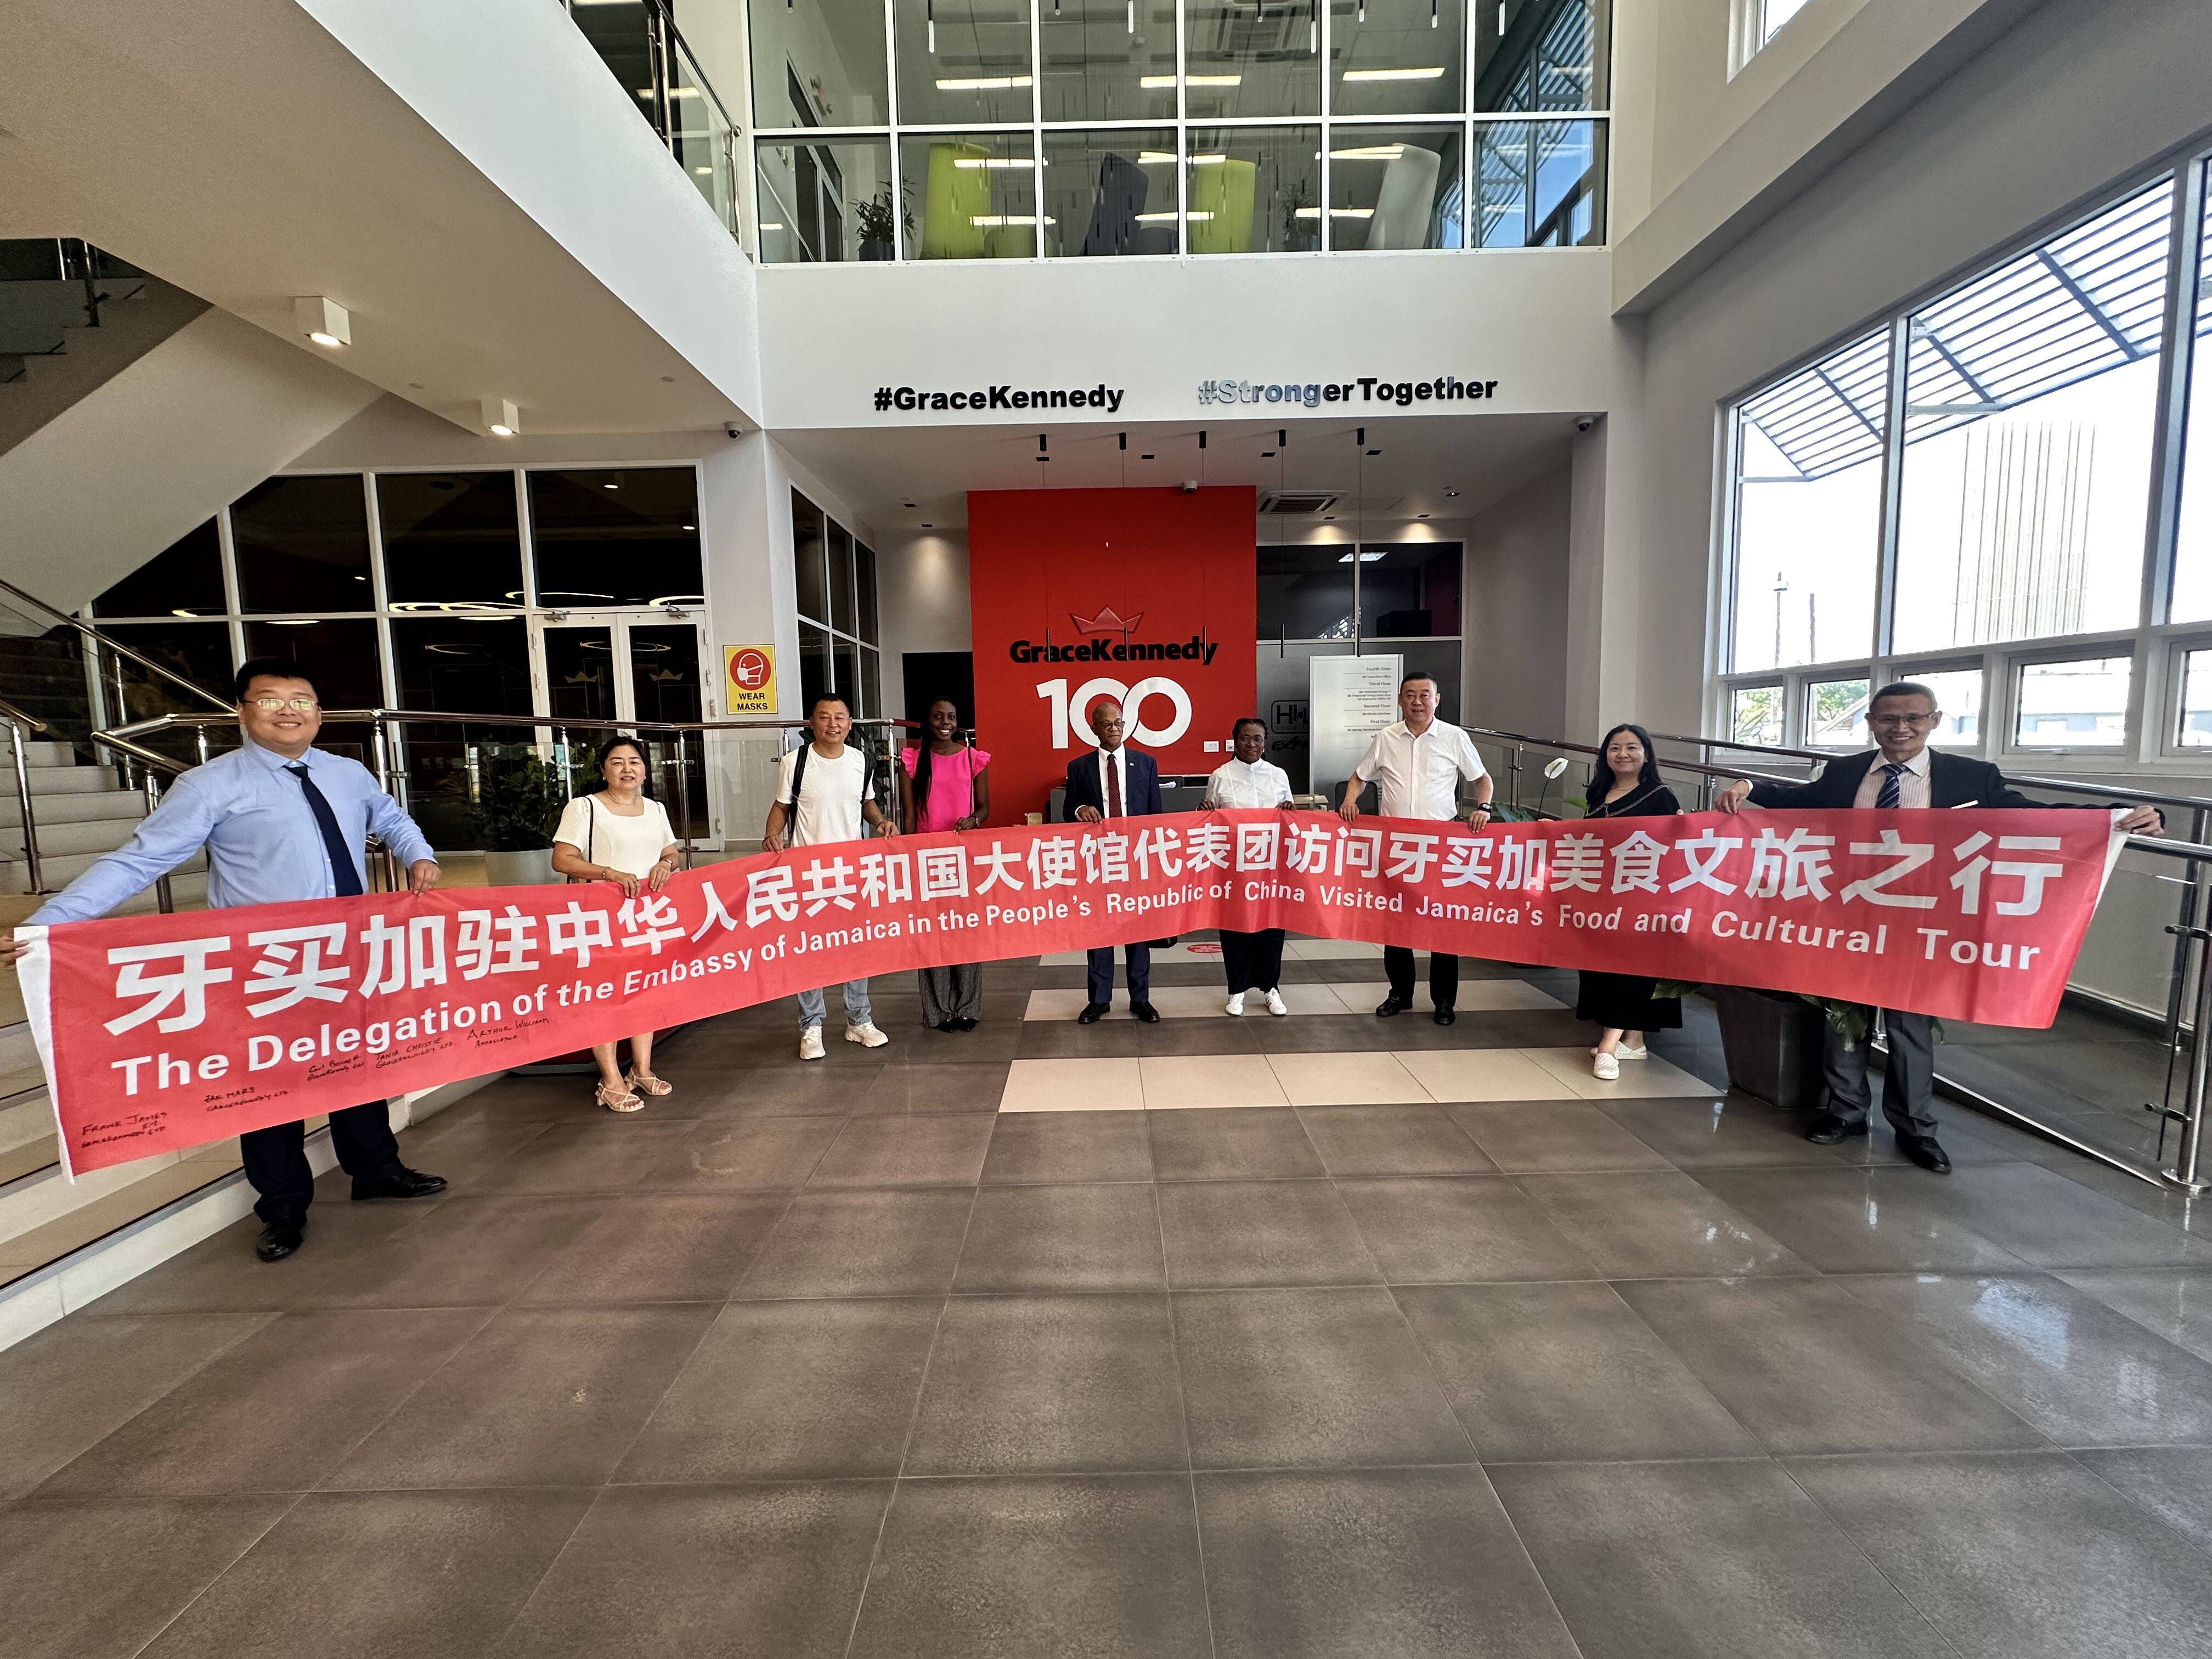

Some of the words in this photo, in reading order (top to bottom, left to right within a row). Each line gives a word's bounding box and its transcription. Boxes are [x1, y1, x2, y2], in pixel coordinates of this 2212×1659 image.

[874, 384, 1124, 413] #GraceKennedy
[1198, 376, 1498, 407] #StrongerTogether
[1009, 635, 1218, 665] GraceKennedy
[1036, 676, 1192, 749] 100
[103, 822, 2063, 1036] 牙买加驻中华人民共和国大使馆代表团访问牙买加美食文旅之行
[111, 1053, 229, 1096] The
[249, 1001, 501, 1071] Delegation
[512, 984, 548, 1015] of
[556, 980, 614, 1007] the
[623, 947, 753, 995] Embassy
[760, 934, 786, 961] of
[793, 919, 901, 954] Jamaica
[908, 913, 931, 934] in
[937, 909, 979, 931] the
[1107, 885, 1203, 915] Republic
[1209, 881, 1232, 899] of
[1244, 881, 1305, 902] China
[1319, 885, 1402, 912] Visited
[1559, 906, 1622, 930] Food
[1634, 907, 1692, 933] and
[1712, 911, 1887, 954] Cultural
[1917, 928, 2040, 970] Tour
